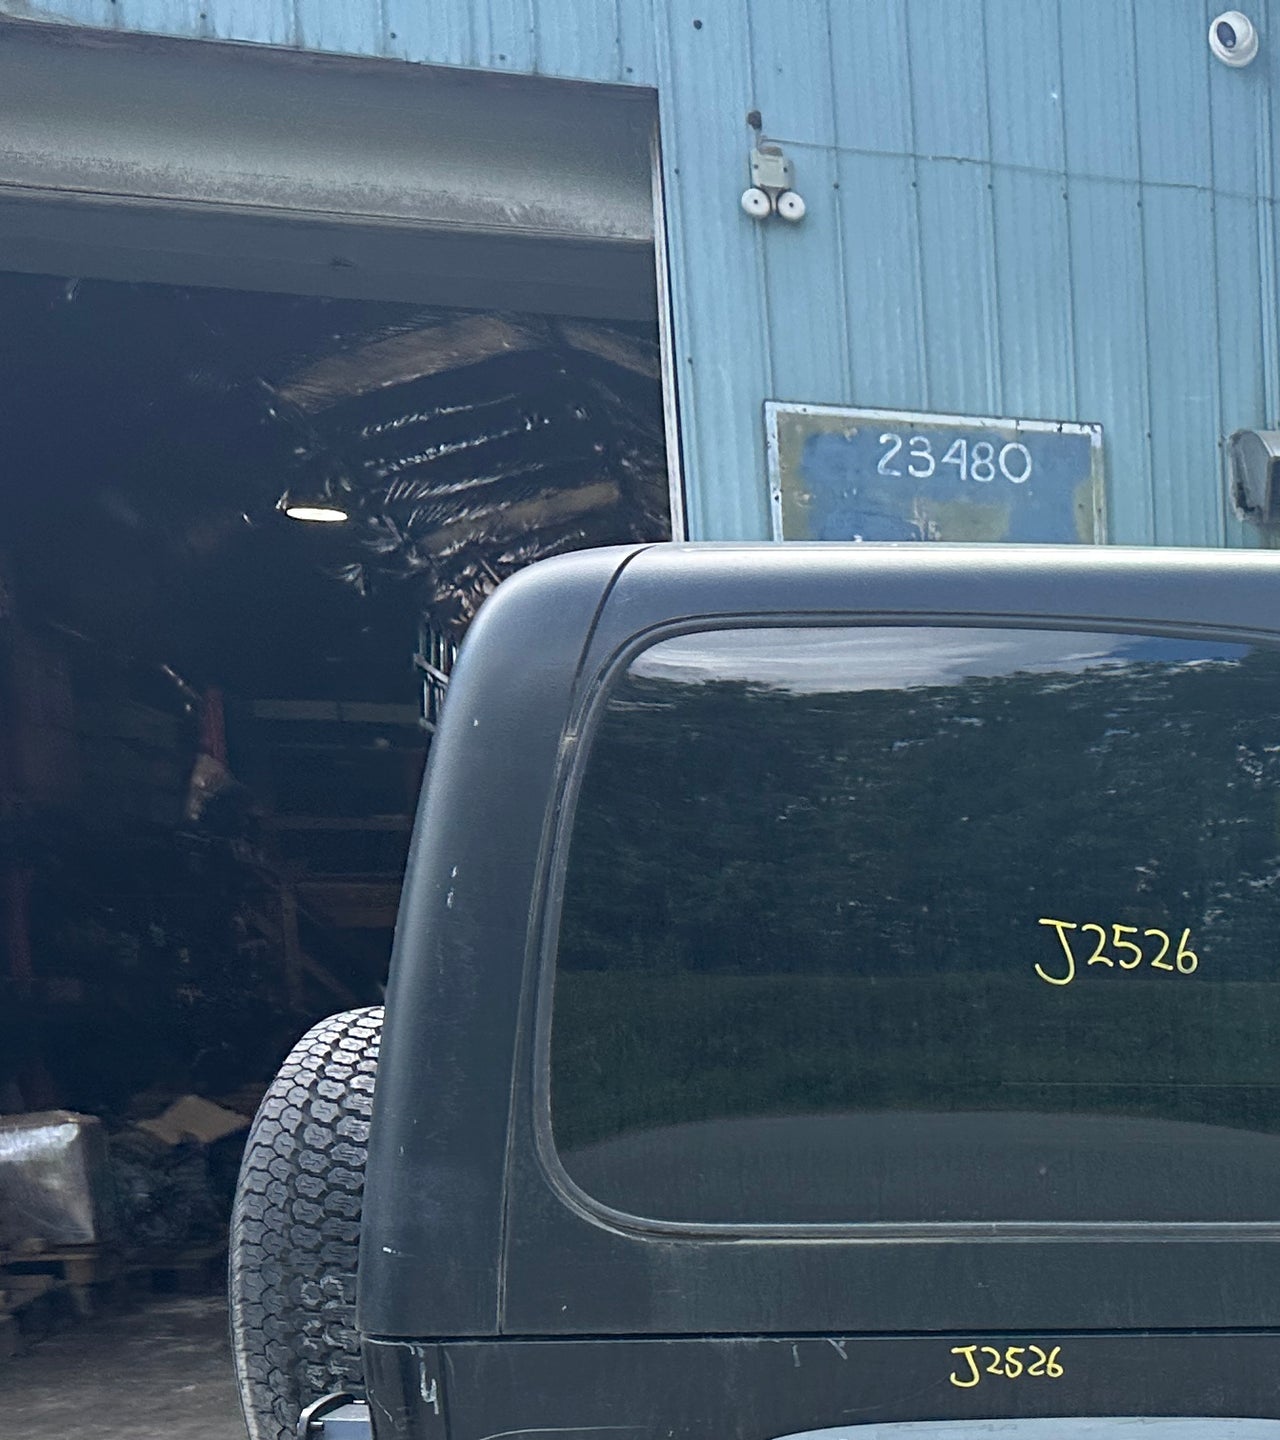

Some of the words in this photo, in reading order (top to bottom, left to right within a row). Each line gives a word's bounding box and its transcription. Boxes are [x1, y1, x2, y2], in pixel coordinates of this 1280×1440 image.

[878, 433, 1032, 484] 23480
[1034, 918, 1199, 986] J2526
[949, 1345, 1064, 1387] J2526
